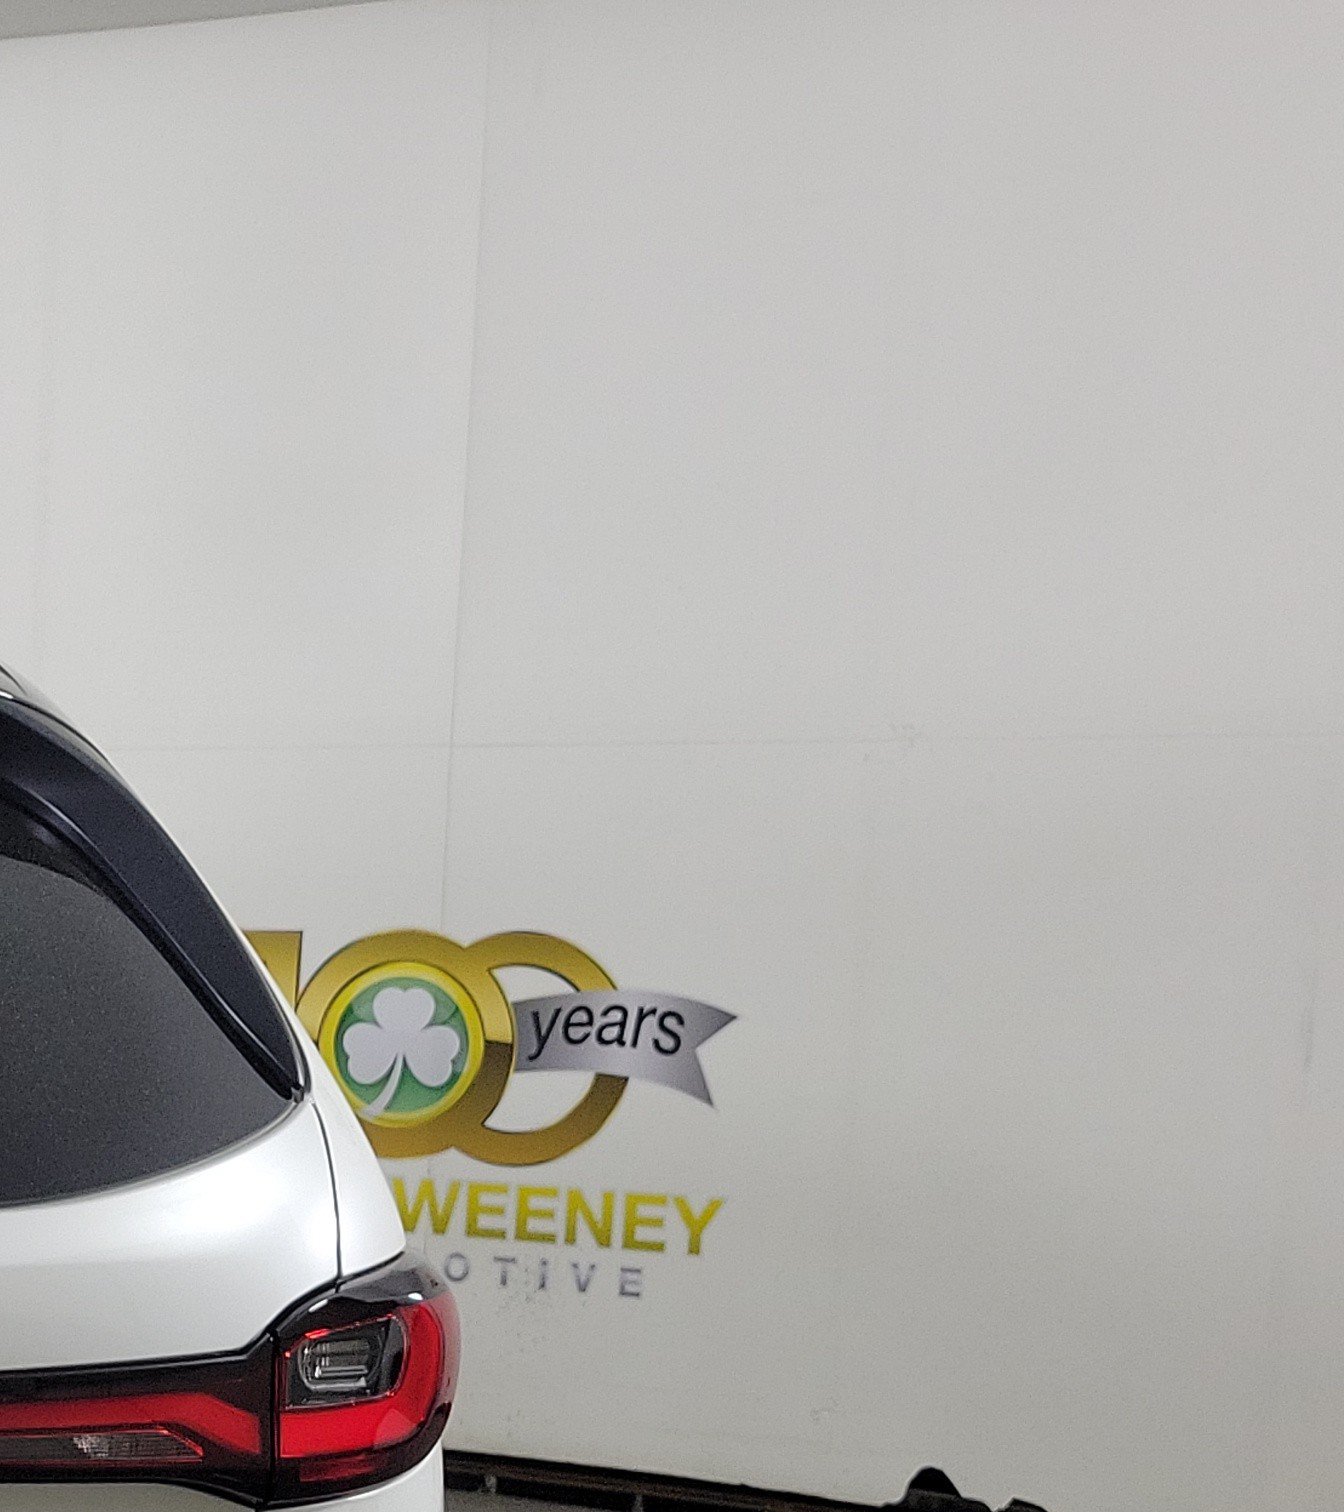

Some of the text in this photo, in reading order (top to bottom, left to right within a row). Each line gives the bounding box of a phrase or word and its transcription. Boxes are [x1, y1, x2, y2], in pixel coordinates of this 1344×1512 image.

[527, 1002, 685, 1063] years
[391, 1177, 725, 1256] WEENEY
[443, 1252, 644, 1299] OTIVE
